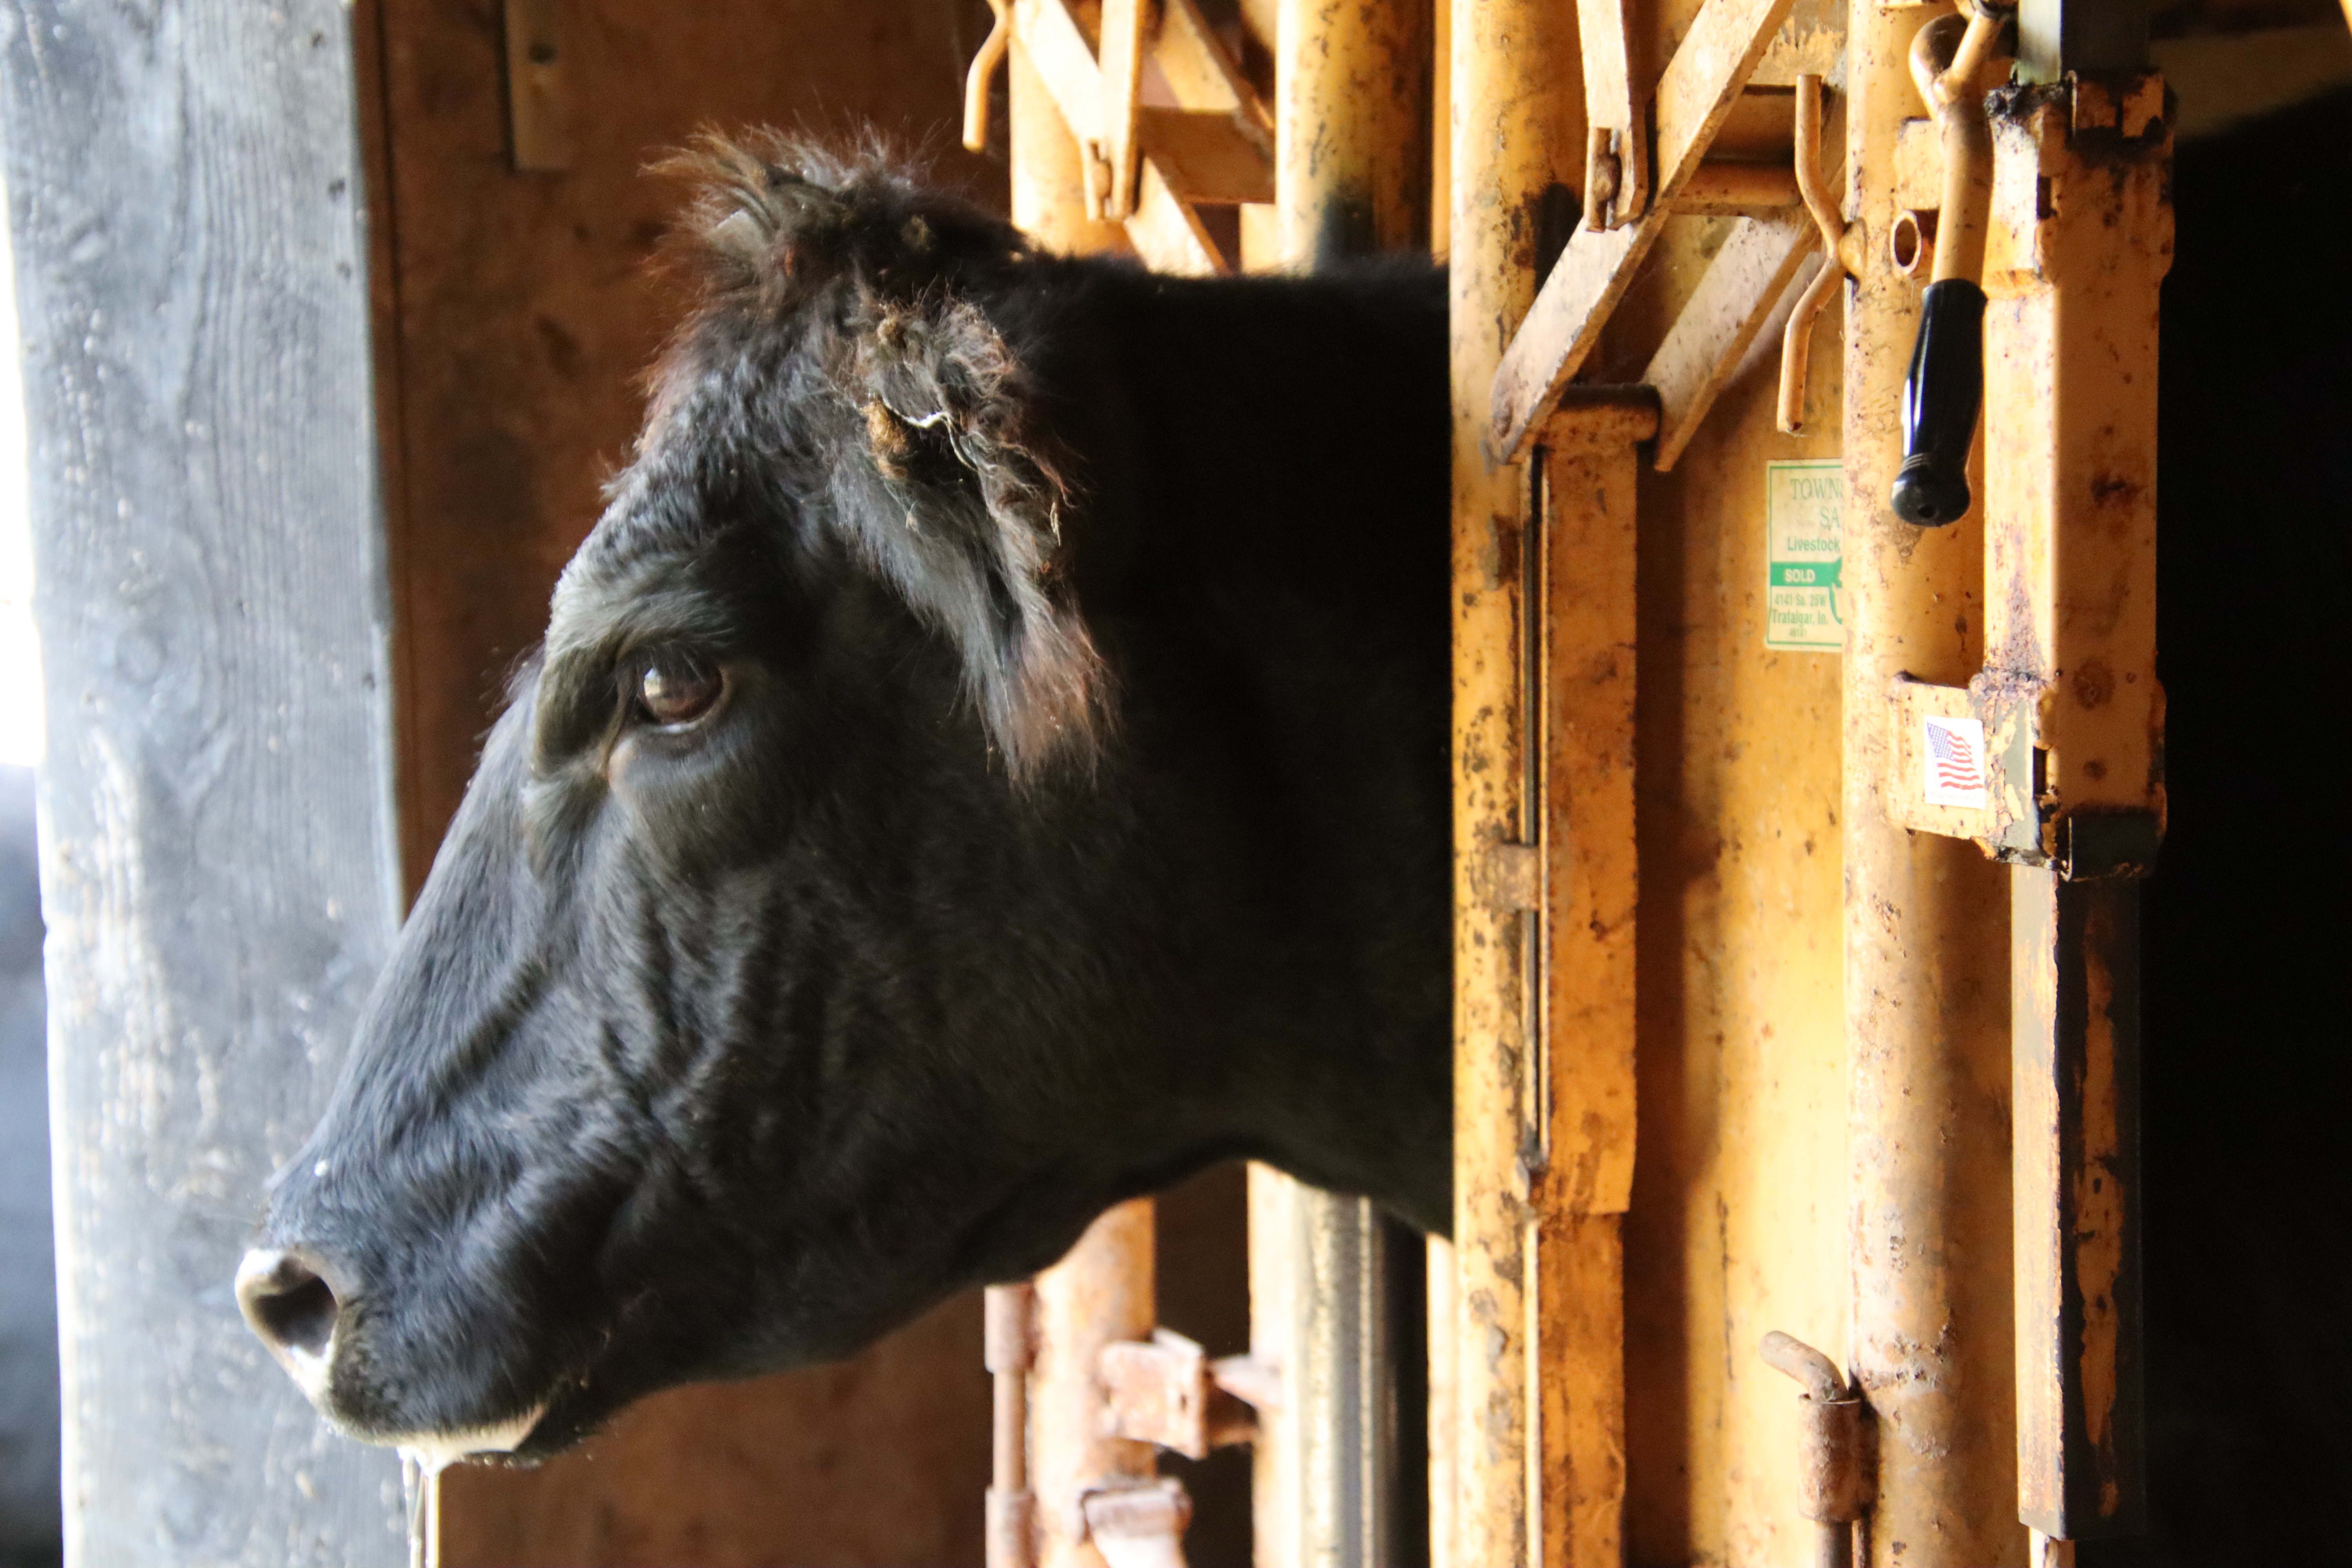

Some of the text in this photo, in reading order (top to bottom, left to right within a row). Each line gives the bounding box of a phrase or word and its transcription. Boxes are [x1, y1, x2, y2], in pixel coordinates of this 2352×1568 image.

[1820, 506, 1843, 528] SA
[1788, 536, 1841, 552] Livestock
[1785, 568, 1816, 583] SOLD
[1775, 593, 1793, 605] 4141
[1810, 593, 1827, 606] 25W
[1771, 609, 1829, 627] Trafalgar, In.
